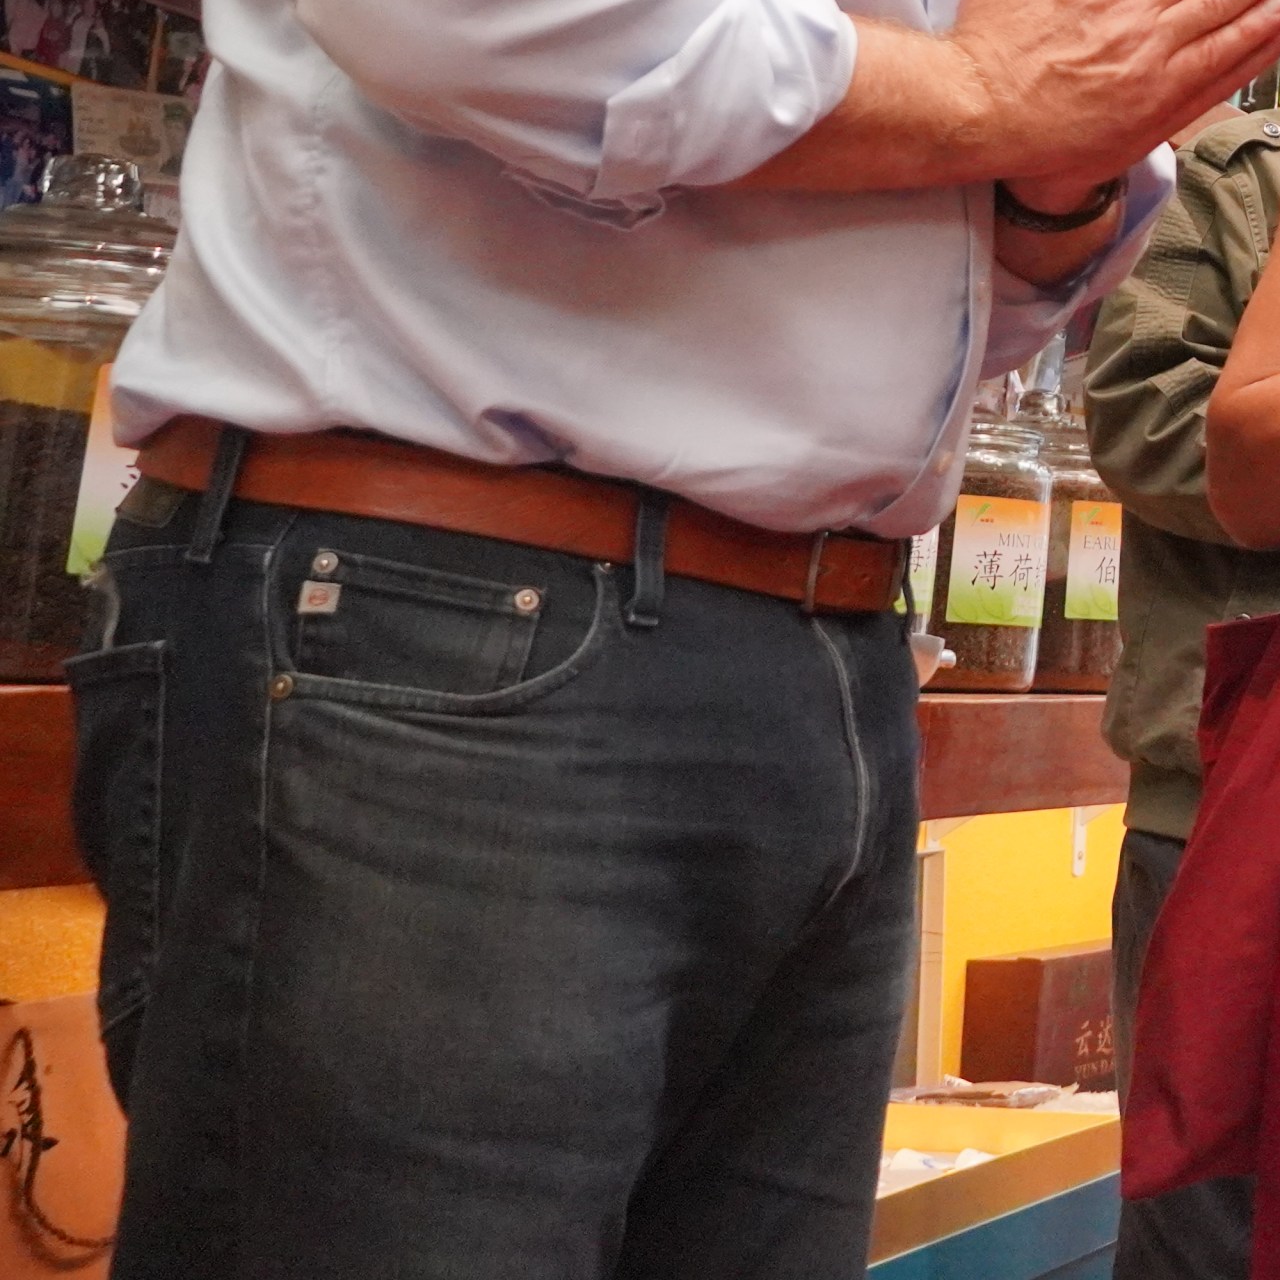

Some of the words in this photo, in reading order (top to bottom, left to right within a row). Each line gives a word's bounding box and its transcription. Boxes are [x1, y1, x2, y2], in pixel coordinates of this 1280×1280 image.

[998, 532, 1031, 549] MINT
[1083, 534, 1119, 550] EARL
[1095, 556, 1116, 585] 伯
